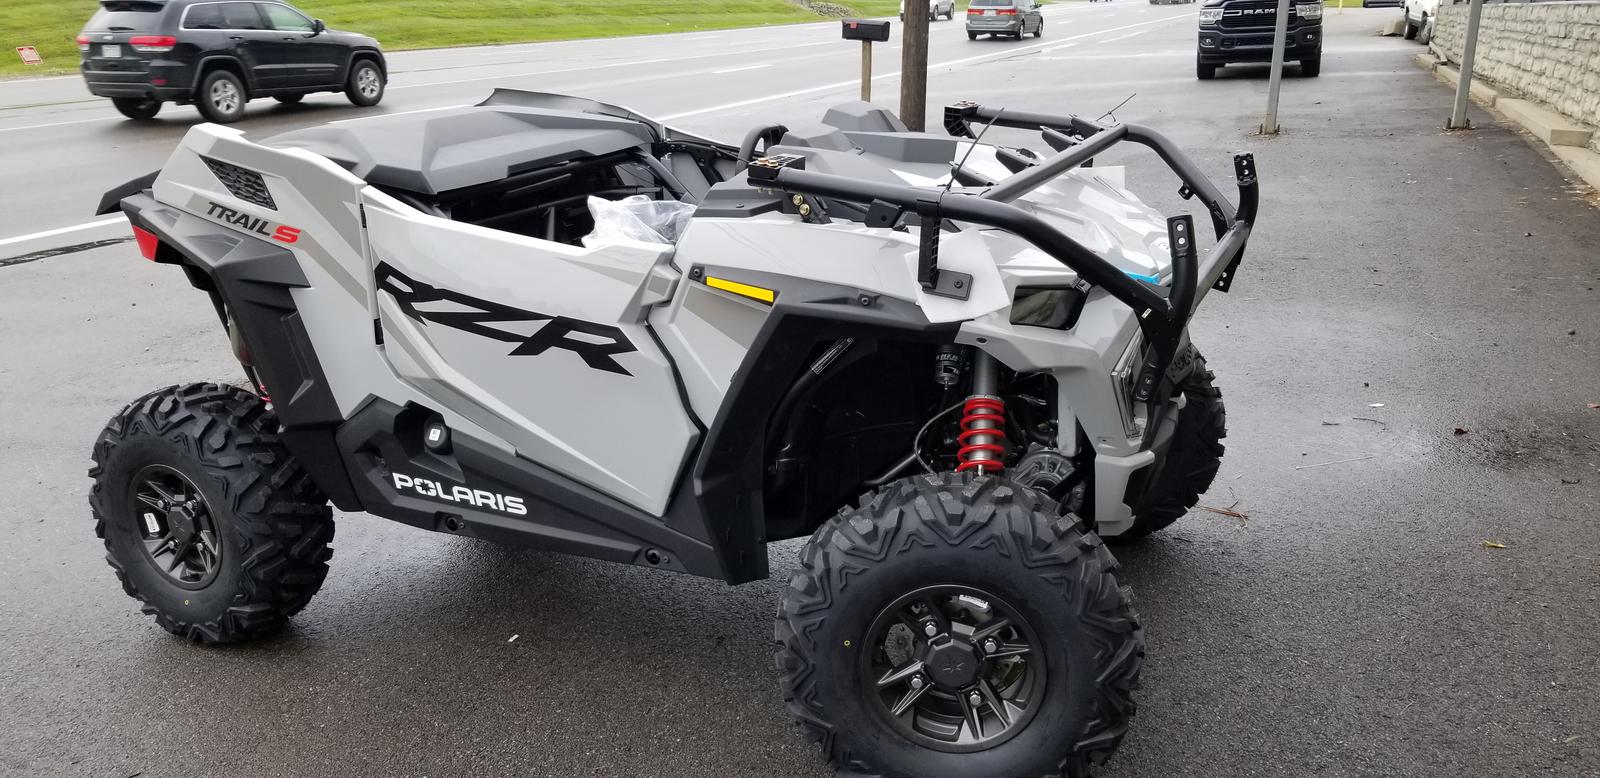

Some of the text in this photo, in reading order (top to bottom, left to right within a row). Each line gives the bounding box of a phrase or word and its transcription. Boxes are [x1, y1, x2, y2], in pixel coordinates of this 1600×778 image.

[207, 201, 302, 244] TRAIL S
[374, 259, 639, 377] RZR
[391, 472, 528, 515] POLARIS
